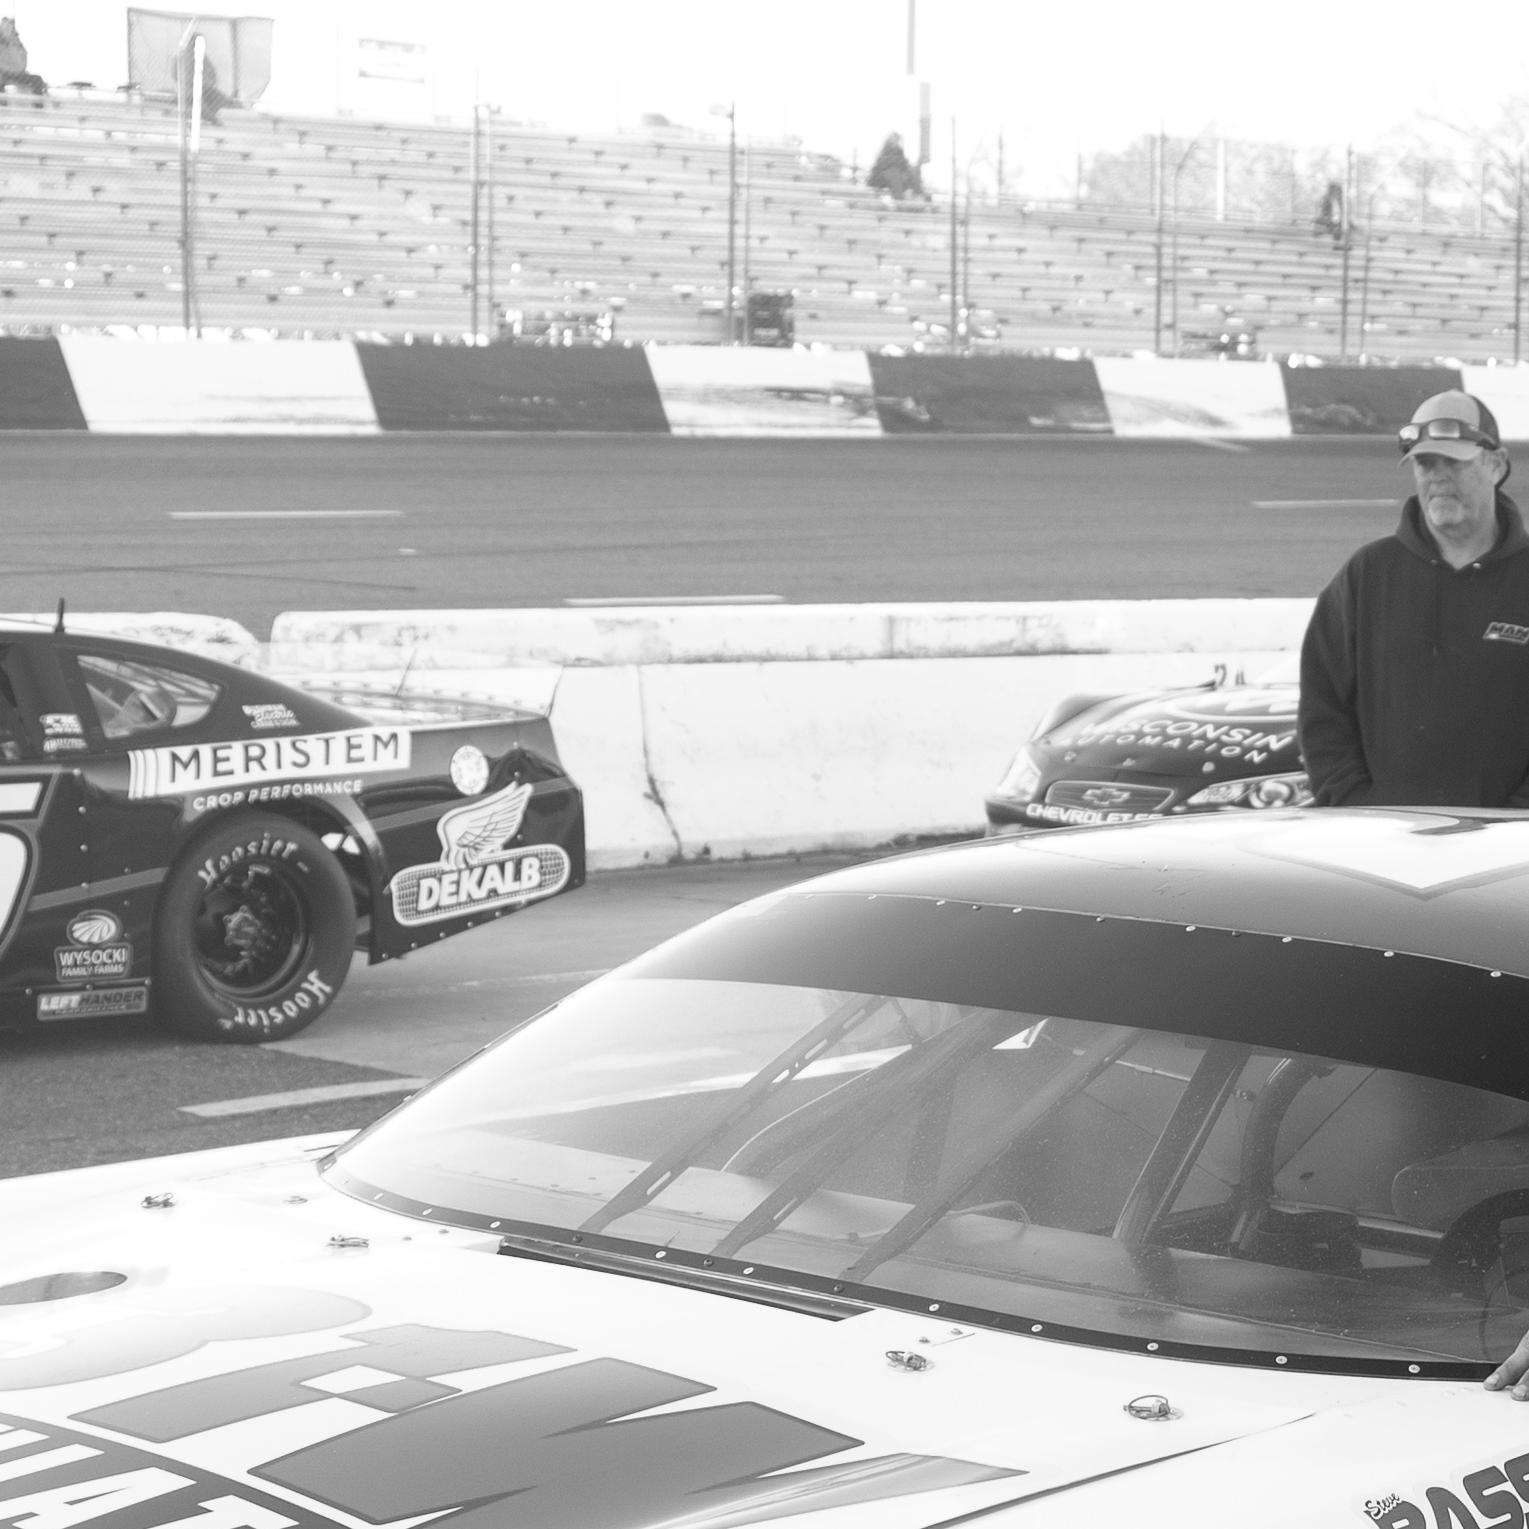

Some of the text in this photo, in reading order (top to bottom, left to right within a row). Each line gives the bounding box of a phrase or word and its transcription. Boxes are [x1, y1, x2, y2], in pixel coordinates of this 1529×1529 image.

[1079, 718, 1294, 752] WSCONSIN
[170, 732, 399, 784] MERISTEM
[193, 779, 364, 811] CROP PERFORMANCE
[1026, 802, 1133, 824] CHEVROLET
[198, 832, 298, 891] Hoosier
[417, 856, 542, 912] DEKALB
[59, 948, 127, 967] WYSOCKI
[62, 963, 124, 977] FAMILY FARMS
[234, 969, 332, 1034] Hoosier
[1363, 1493, 1403, 1520] Steve
